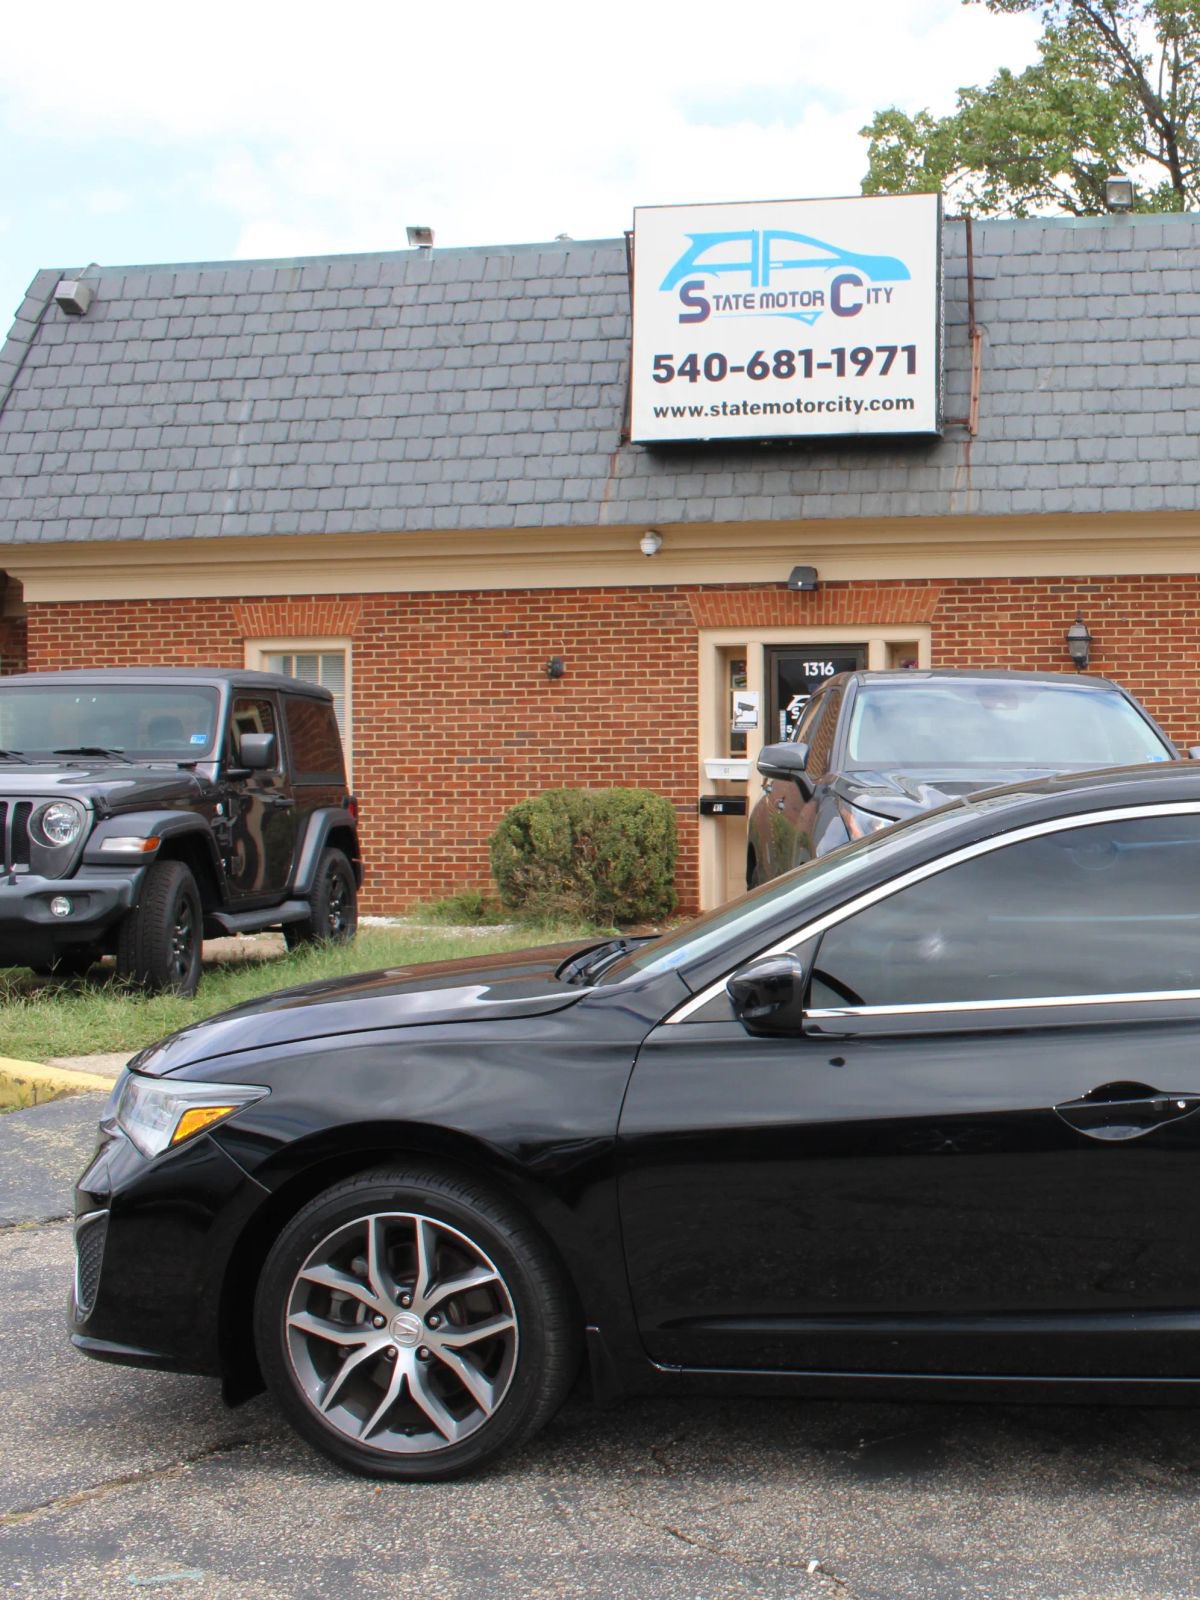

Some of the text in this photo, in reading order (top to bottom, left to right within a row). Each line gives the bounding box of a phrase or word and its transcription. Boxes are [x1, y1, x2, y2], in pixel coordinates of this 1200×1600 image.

[759, 290, 825, 309] MOTOR
[830, 273, 893, 318] CITY
[652, 345, 916, 384] 540-681-1971
[653, 396, 915, 418] www.statemotorcity.com
[803, 661, 835, 677] 1316
